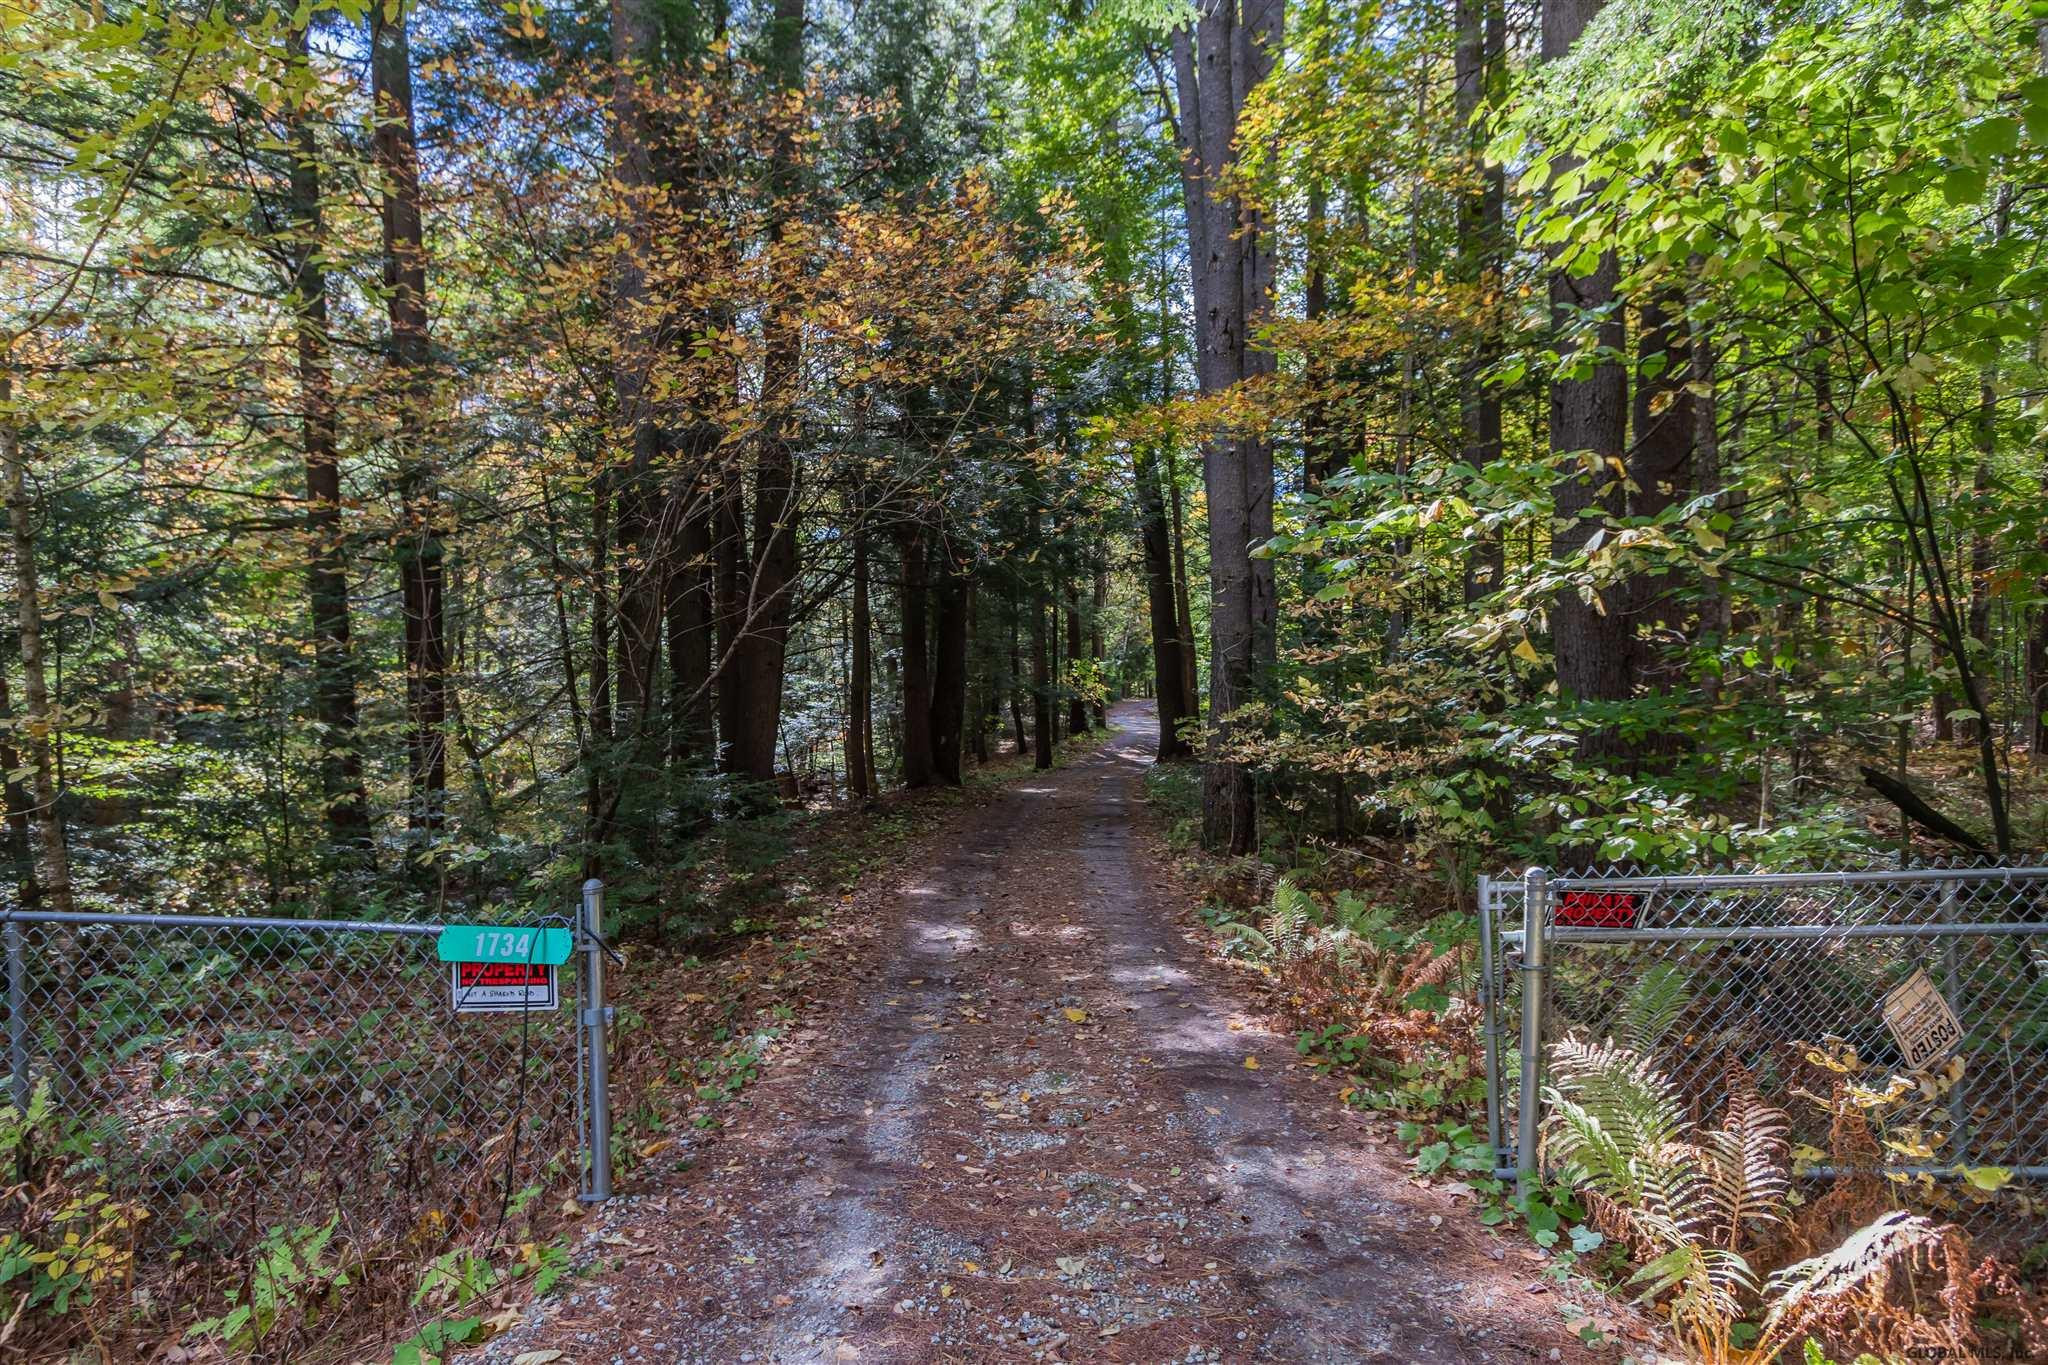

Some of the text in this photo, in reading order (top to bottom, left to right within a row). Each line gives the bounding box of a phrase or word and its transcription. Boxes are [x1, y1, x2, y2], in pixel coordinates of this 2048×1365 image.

[476, 932, 529, 957] 1734
[461, 963, 545, 977] PROPERTY
[1911, 1018, 1957, 1064] POSTED
